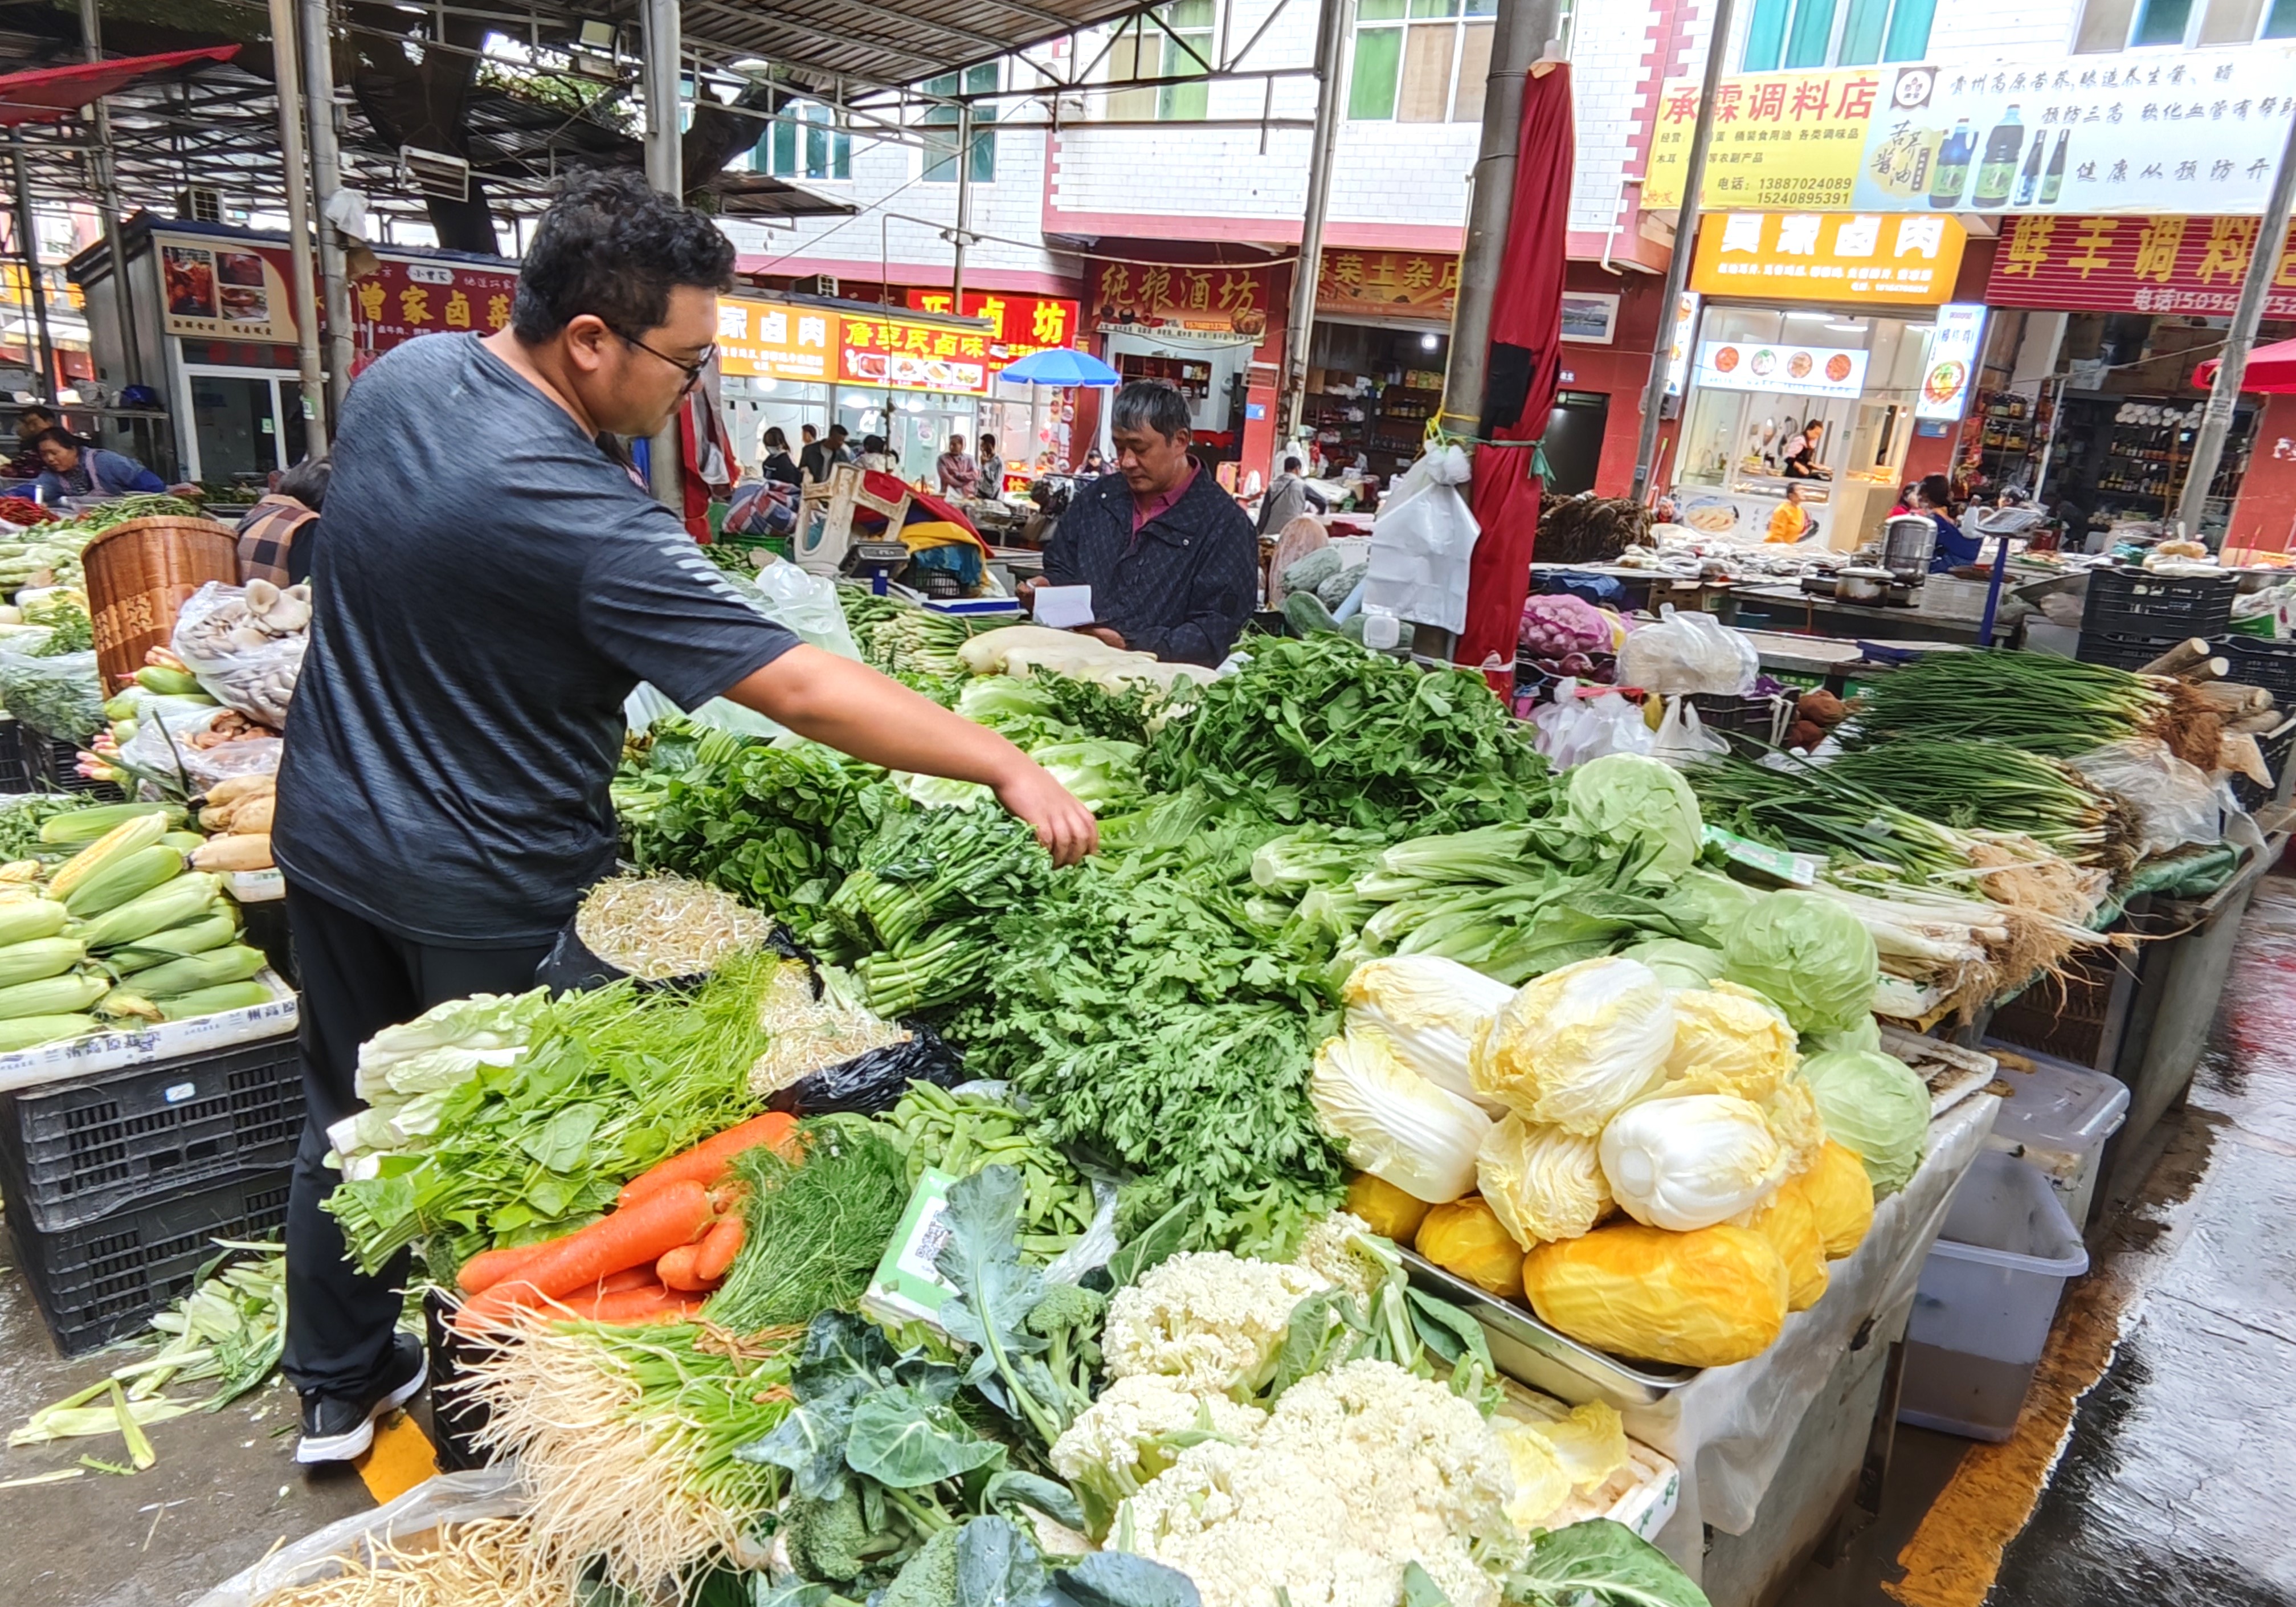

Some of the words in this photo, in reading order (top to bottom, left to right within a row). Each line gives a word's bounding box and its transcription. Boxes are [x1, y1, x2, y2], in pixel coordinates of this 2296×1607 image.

[1663, 76, 1880, 124] 承霖调料店
[2042, 101, 2123, 124] 预防三高
[1759, 177, 1852, 190] 13887024089
[1756, 192, 1850, 205] 15240895391
[1101, 263, 1260, 319] 纯粮酒坊
